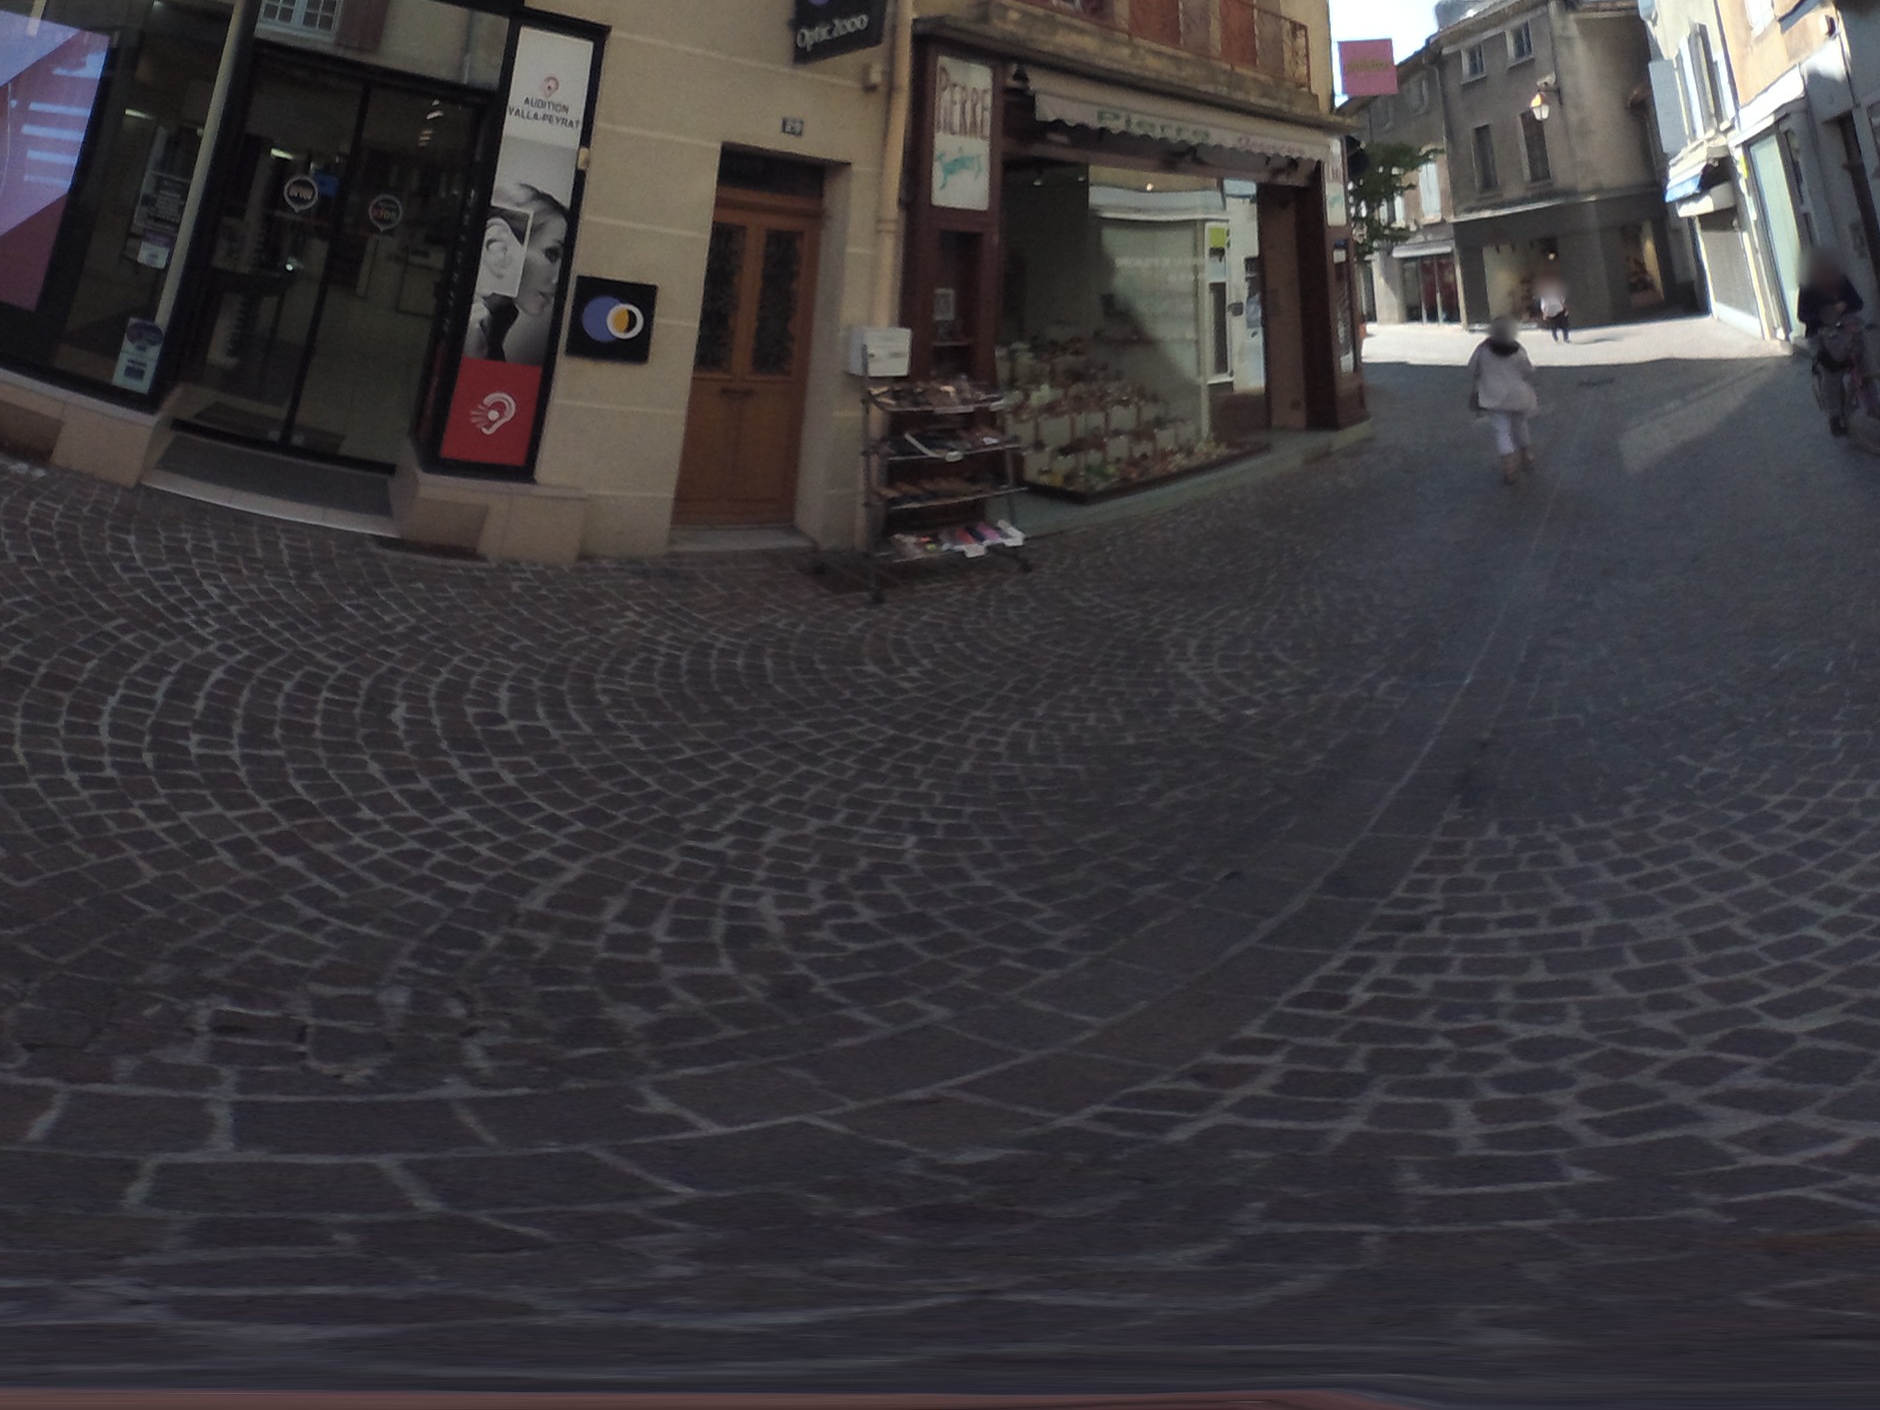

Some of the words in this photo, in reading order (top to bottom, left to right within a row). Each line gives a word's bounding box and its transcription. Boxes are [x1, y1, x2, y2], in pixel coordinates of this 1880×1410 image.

[796, 24, 831, 53] Optic
[831, 14, 869, 38] 2000
[524, 97, 569, 115] AUDITION
